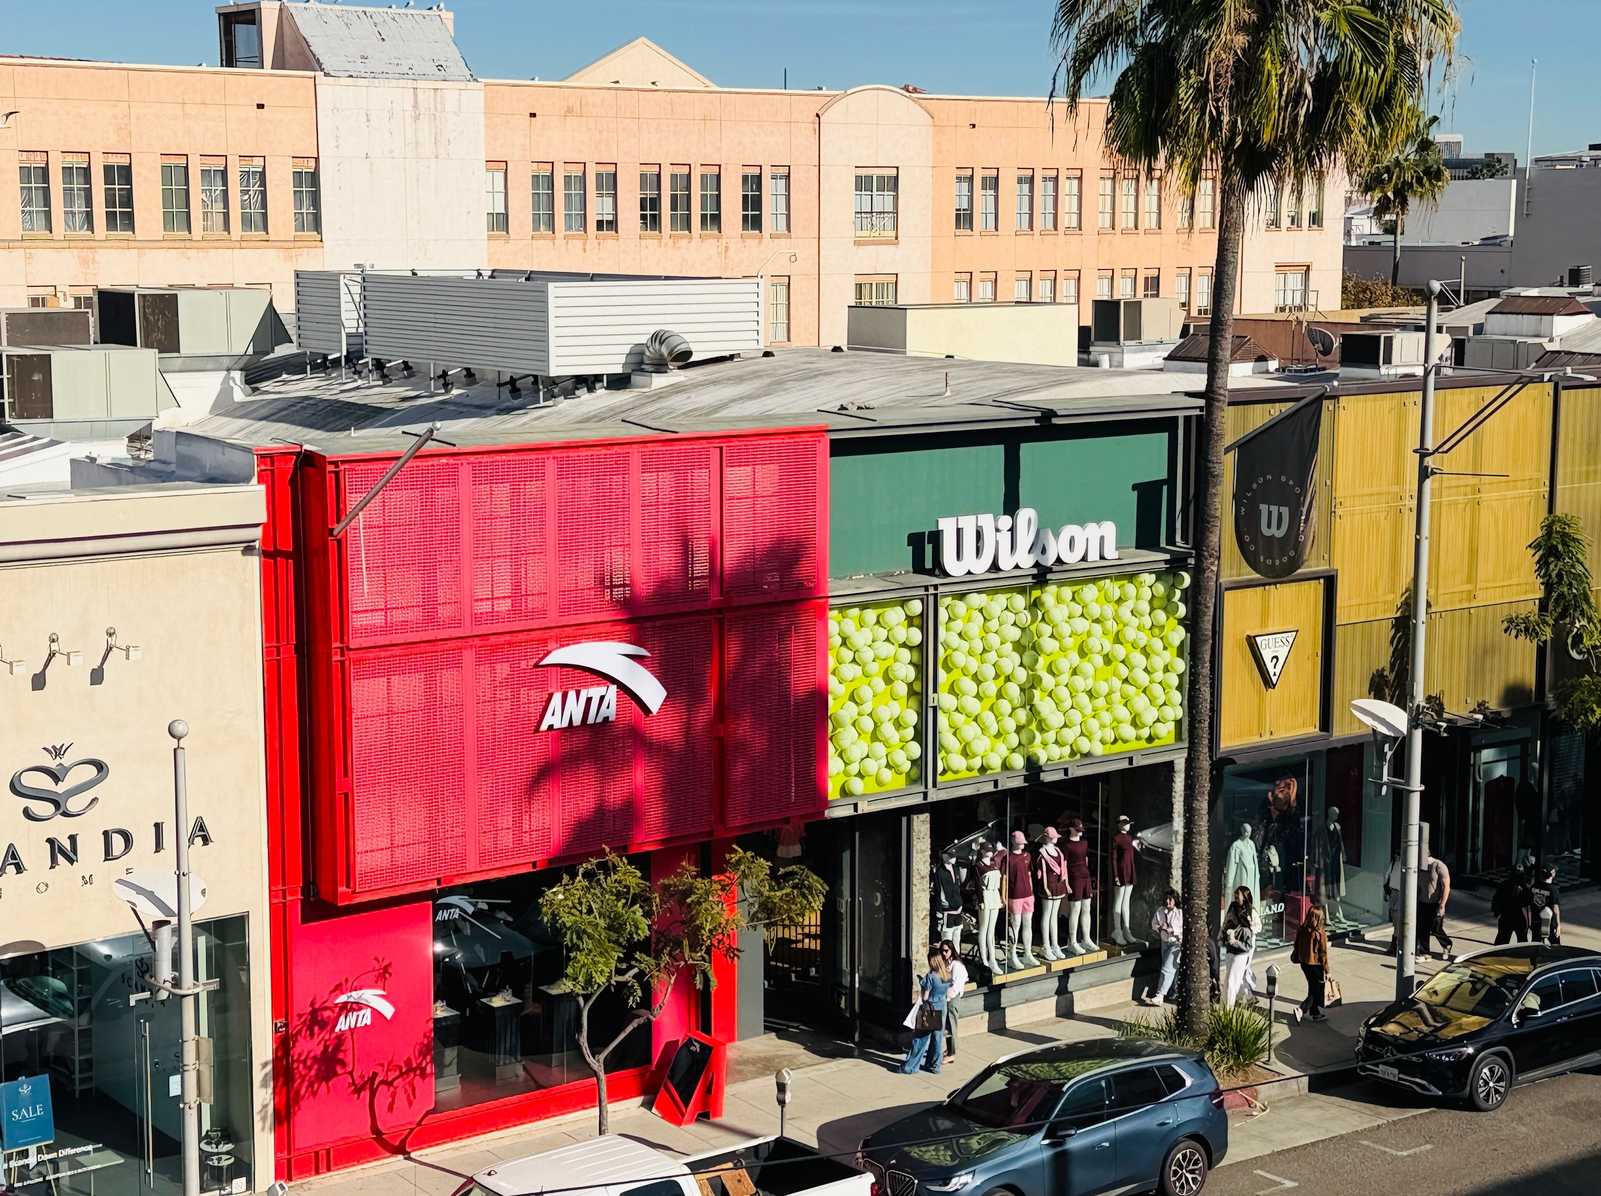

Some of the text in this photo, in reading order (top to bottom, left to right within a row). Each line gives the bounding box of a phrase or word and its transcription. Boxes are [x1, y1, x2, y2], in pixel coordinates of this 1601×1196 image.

[936, 507, 1120, 578] Wilson
[1260, 635, 1290, 650] GUESS
[1270, 654, 1280, 677] ?
[539, 684, 617, 732] ANTA
[435, 907, 460, 922] ANTA
[334, 1007, 371, 1033] ANTA
[11, 1103, 45, 1121] SALE
